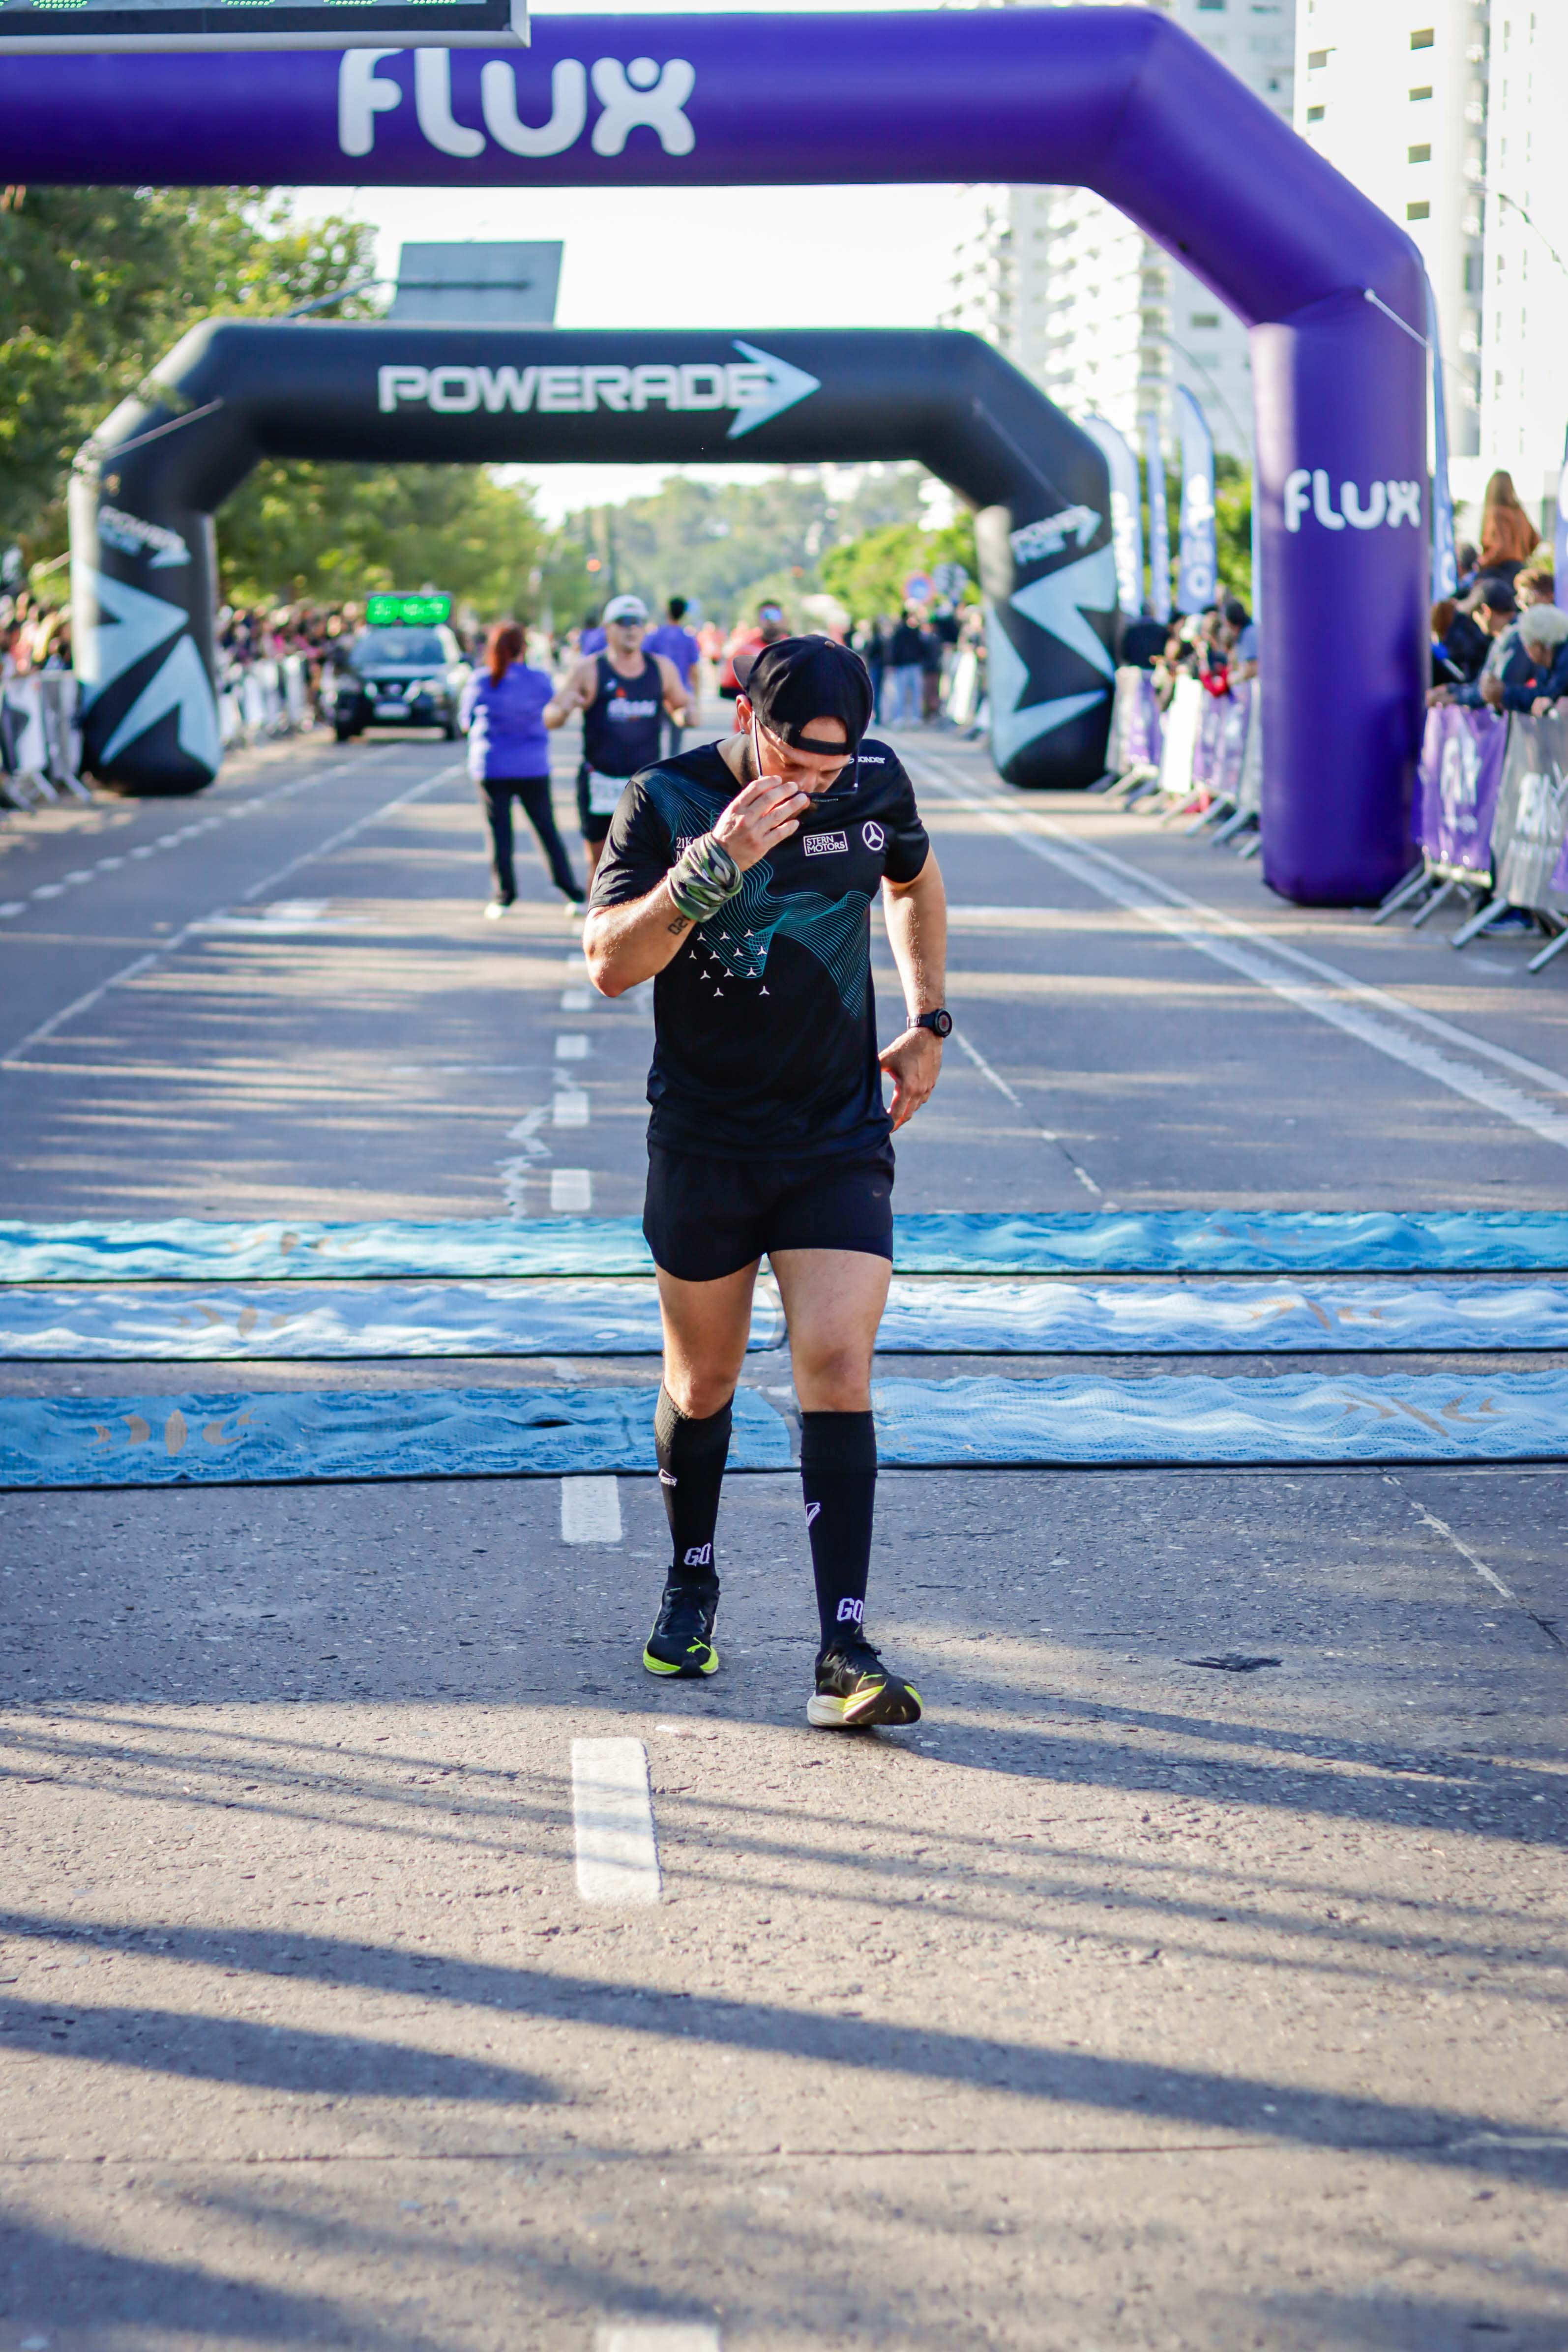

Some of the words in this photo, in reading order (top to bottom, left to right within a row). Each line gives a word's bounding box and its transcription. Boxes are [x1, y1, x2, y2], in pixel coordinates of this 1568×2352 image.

[378, 363, 771, 413] POWERADE
[676, 837, 692, 849] 21K
[806, 835, 834, 846] STERN
[807, 841, 845, 853] MOTORS
